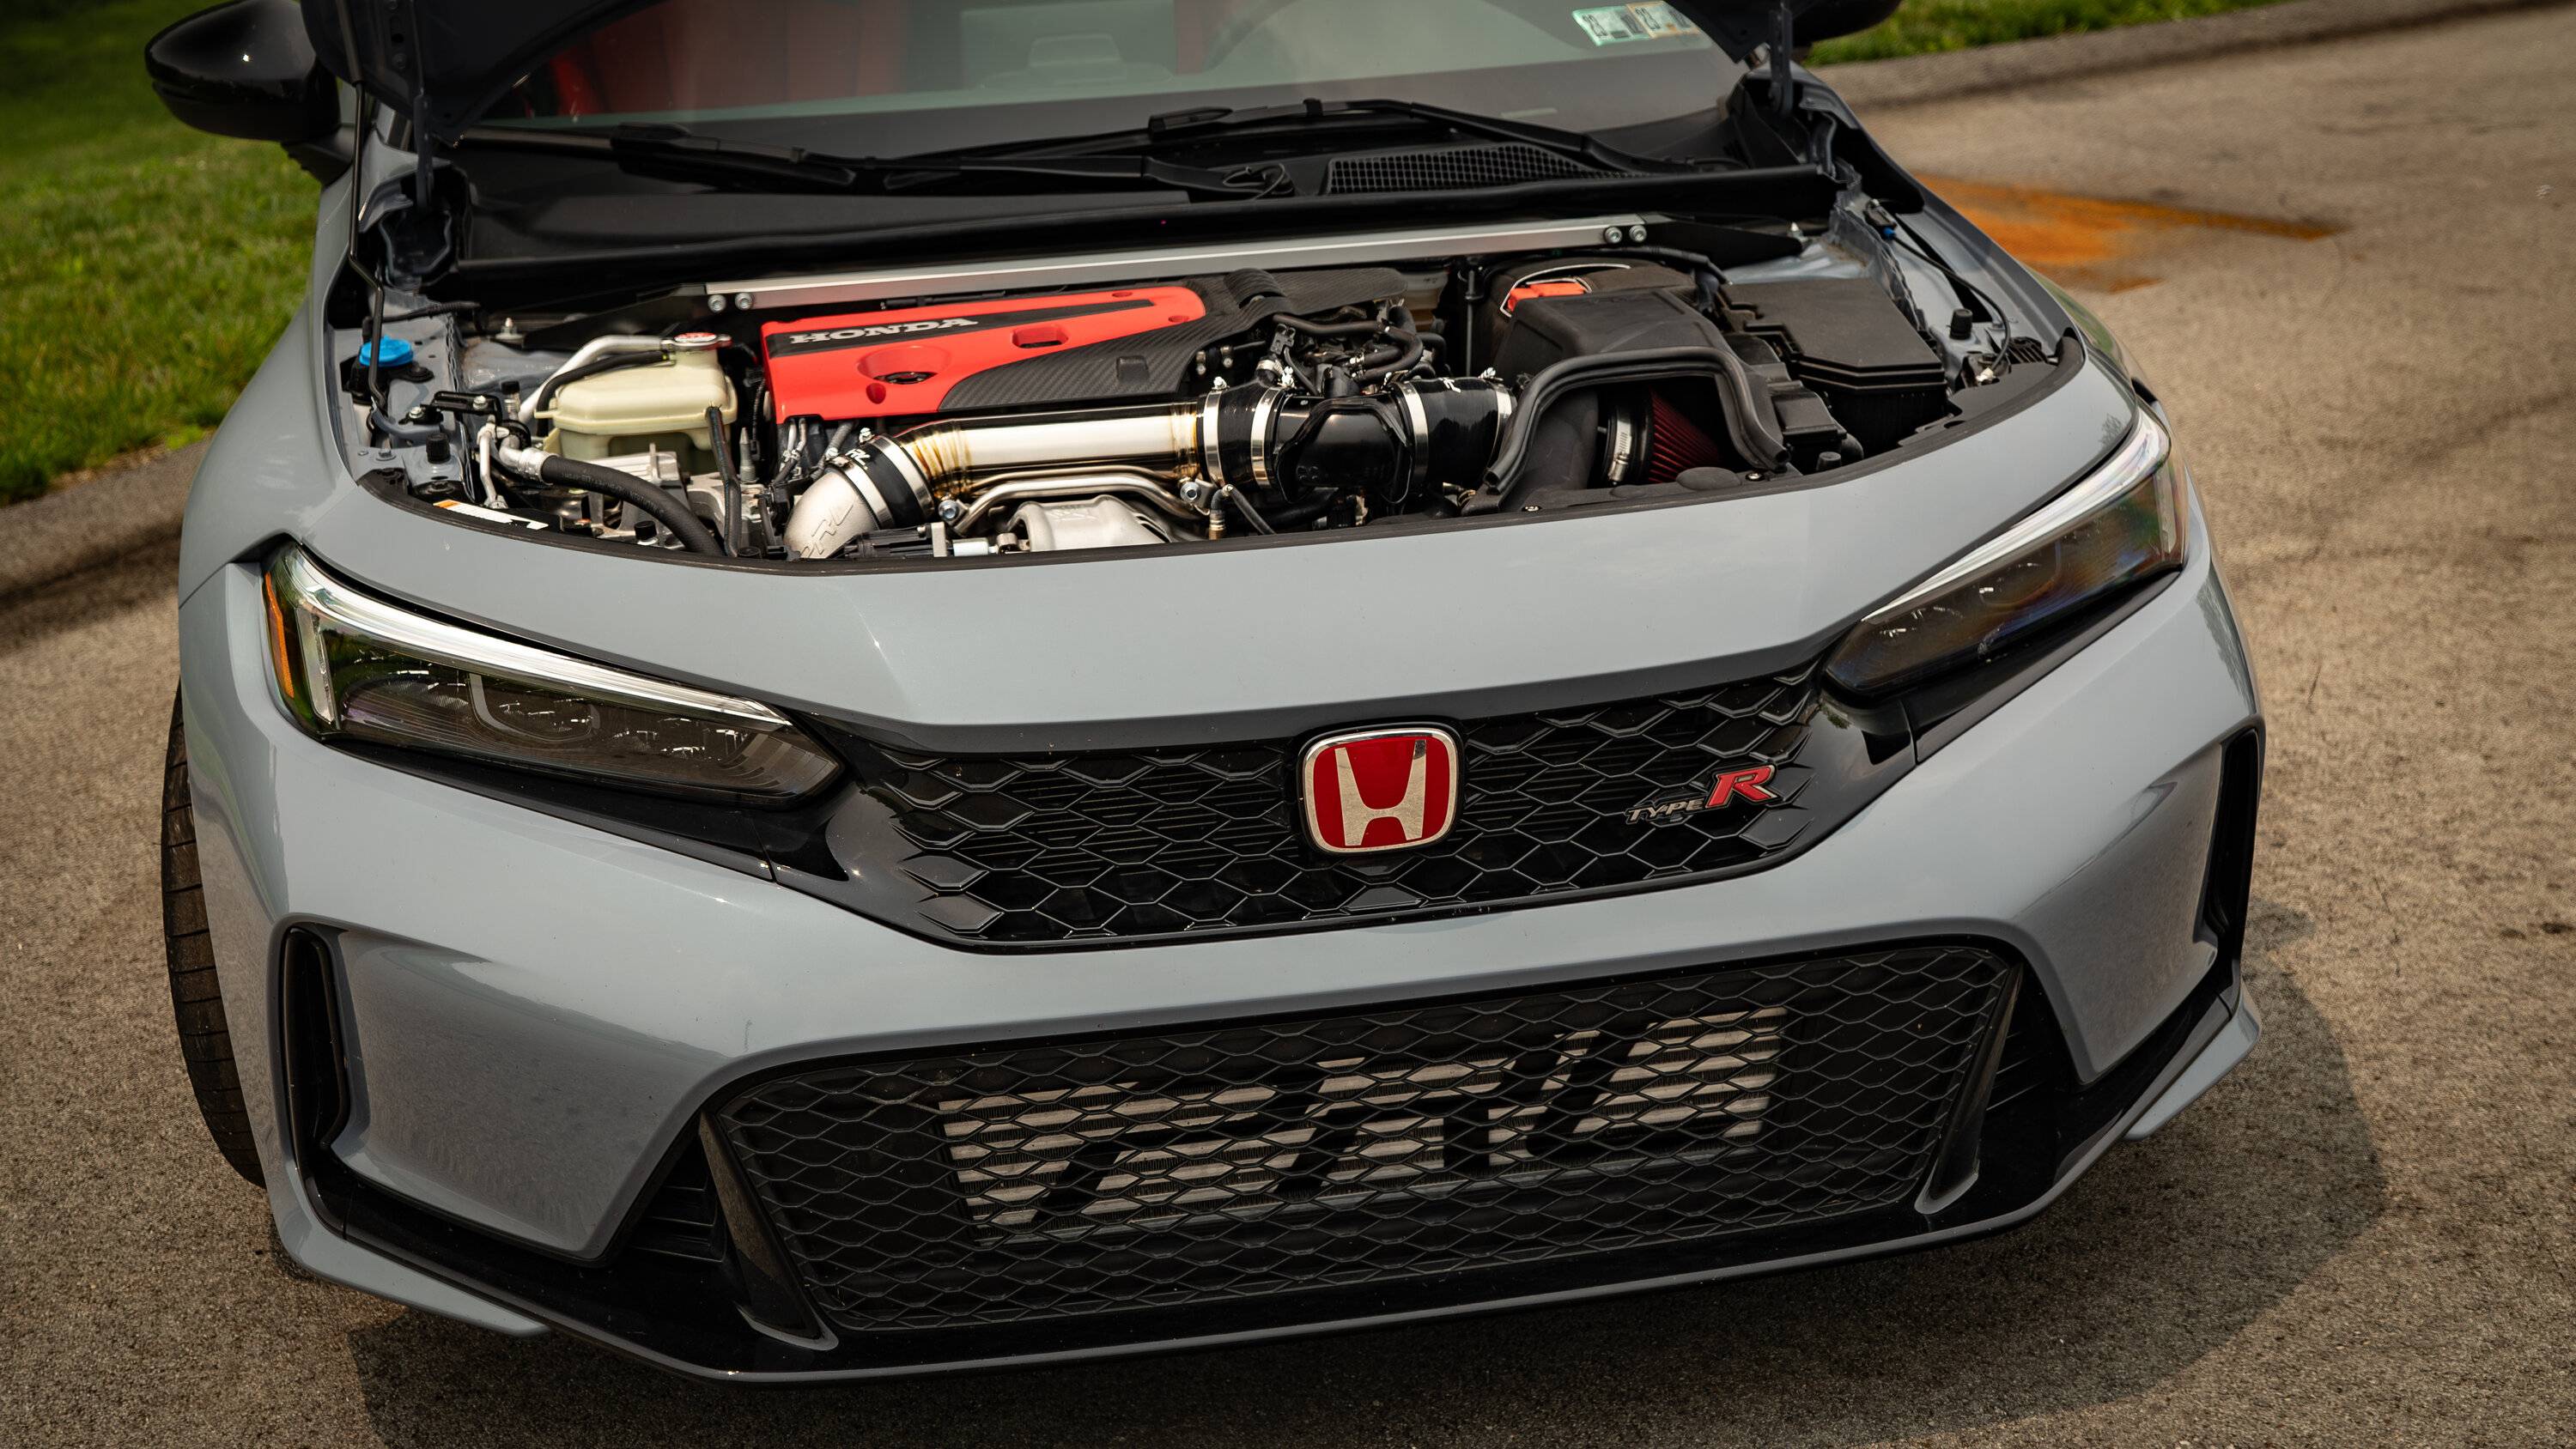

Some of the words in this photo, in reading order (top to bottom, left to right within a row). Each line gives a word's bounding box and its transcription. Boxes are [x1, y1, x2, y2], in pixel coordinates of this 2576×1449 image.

[788, 318, 979, 344] HONDA
[1627, 797, 1704, 822] TYPE
[1704, 763, 1779, 809] R
